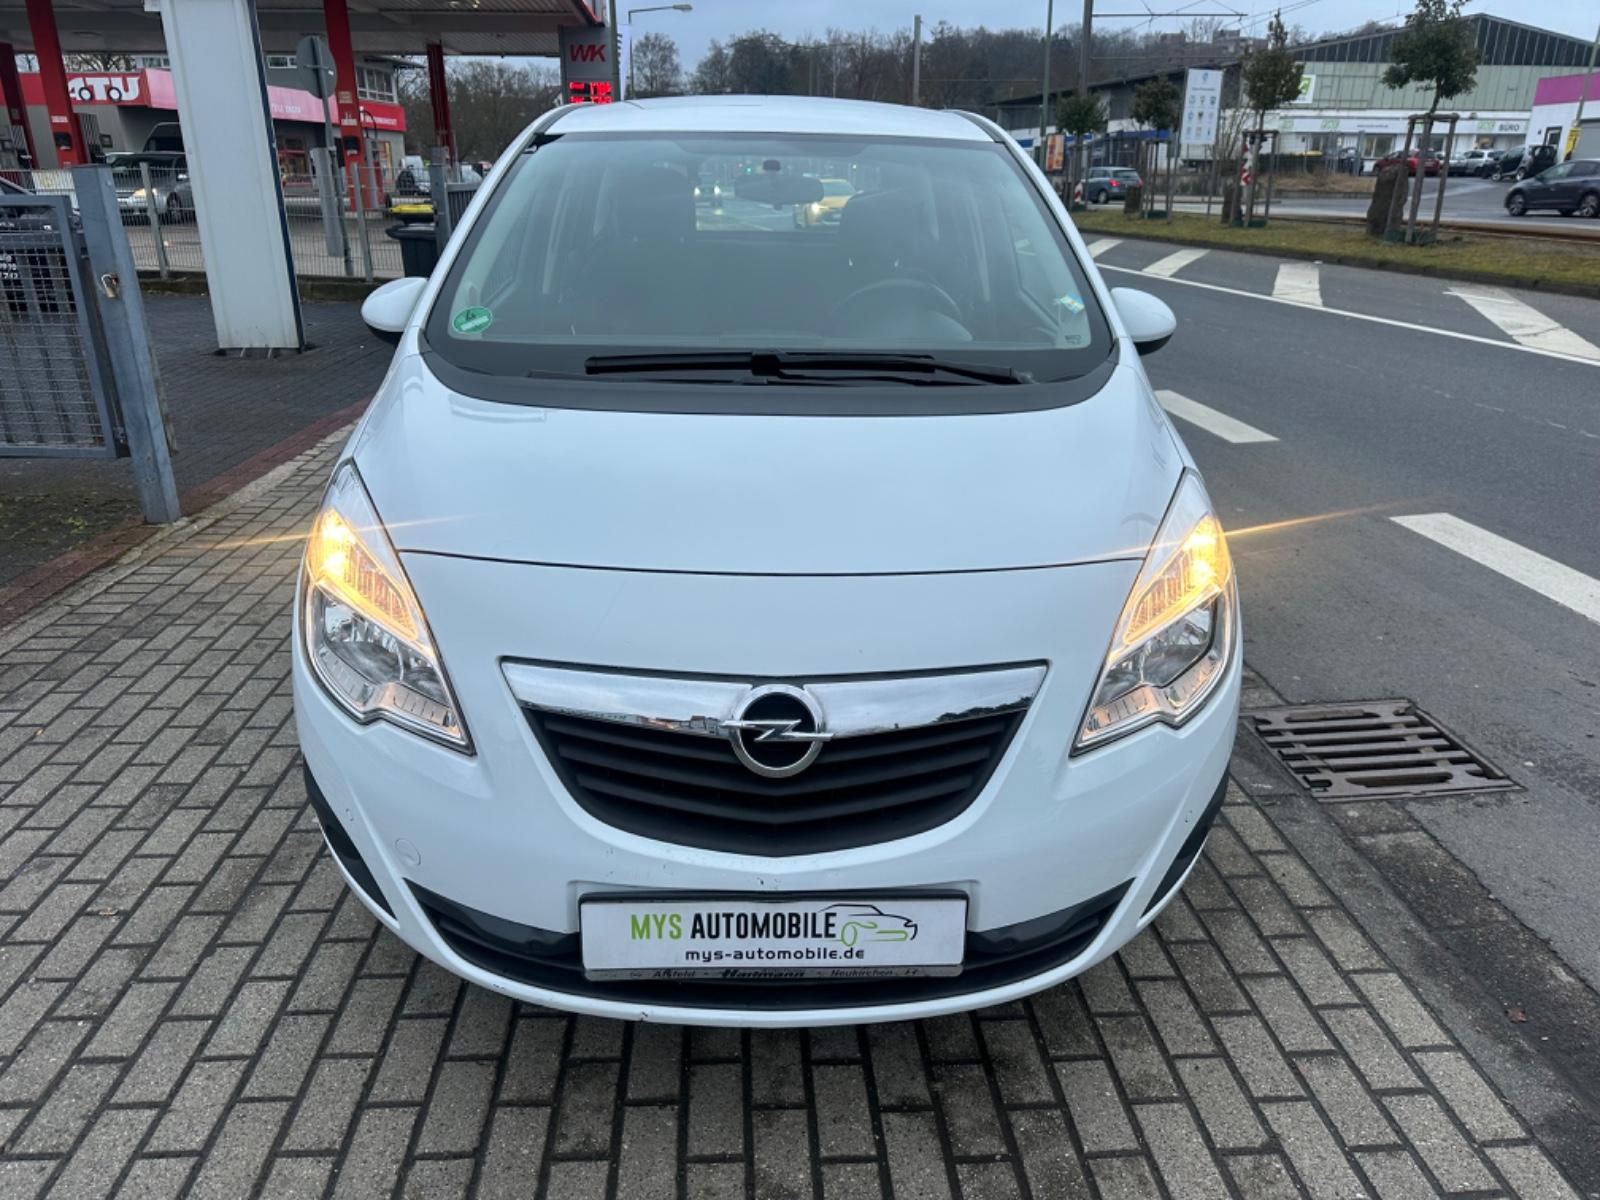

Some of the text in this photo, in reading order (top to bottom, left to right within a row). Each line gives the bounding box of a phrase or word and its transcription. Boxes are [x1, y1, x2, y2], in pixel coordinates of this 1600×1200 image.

[570, 44, 607, 62] WK
[67, 77, 140, 101] ATU
[631, 912, 837, 940] MYS AUTOMOBILE
[685, 947, 865, 962] mys-automobile.de
